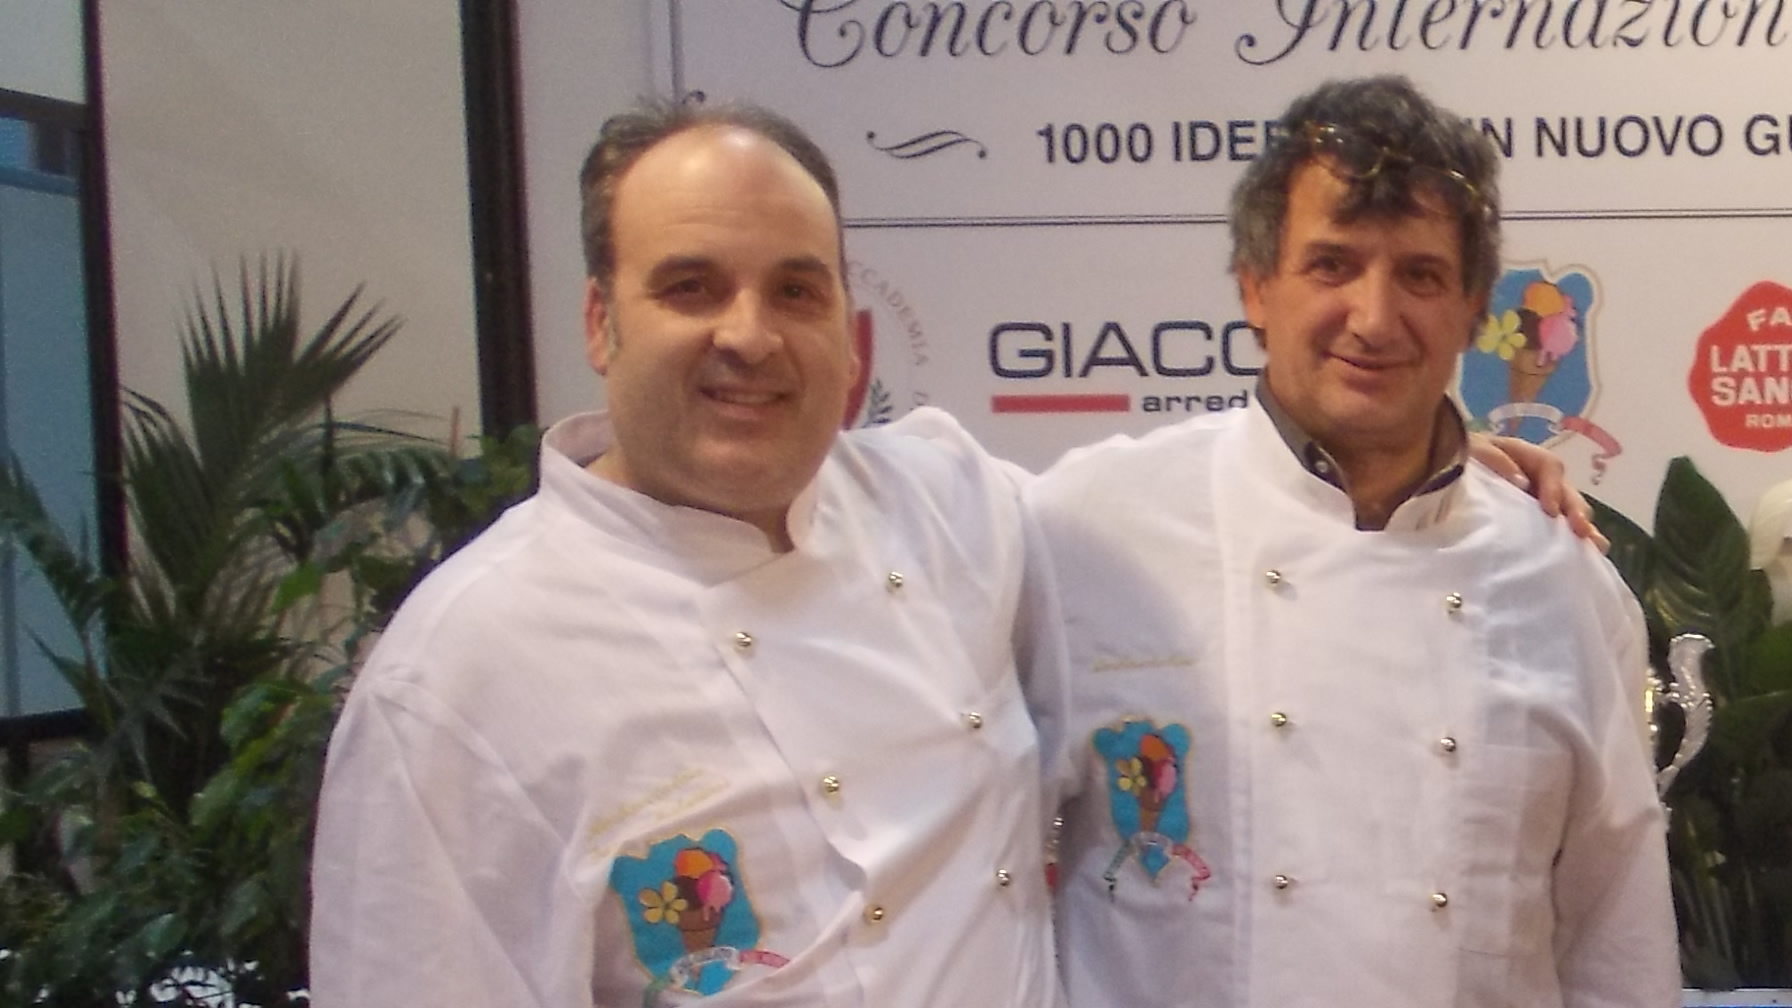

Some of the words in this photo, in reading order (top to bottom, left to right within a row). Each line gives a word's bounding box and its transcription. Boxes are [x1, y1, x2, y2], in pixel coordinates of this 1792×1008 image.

[779, 0, 1197, 68] Concorso
[1036, 122, 1153, 164] 1000
[1464, 116, 1513, 158] N
[1535, 114, 1723, 157] NUOVO
